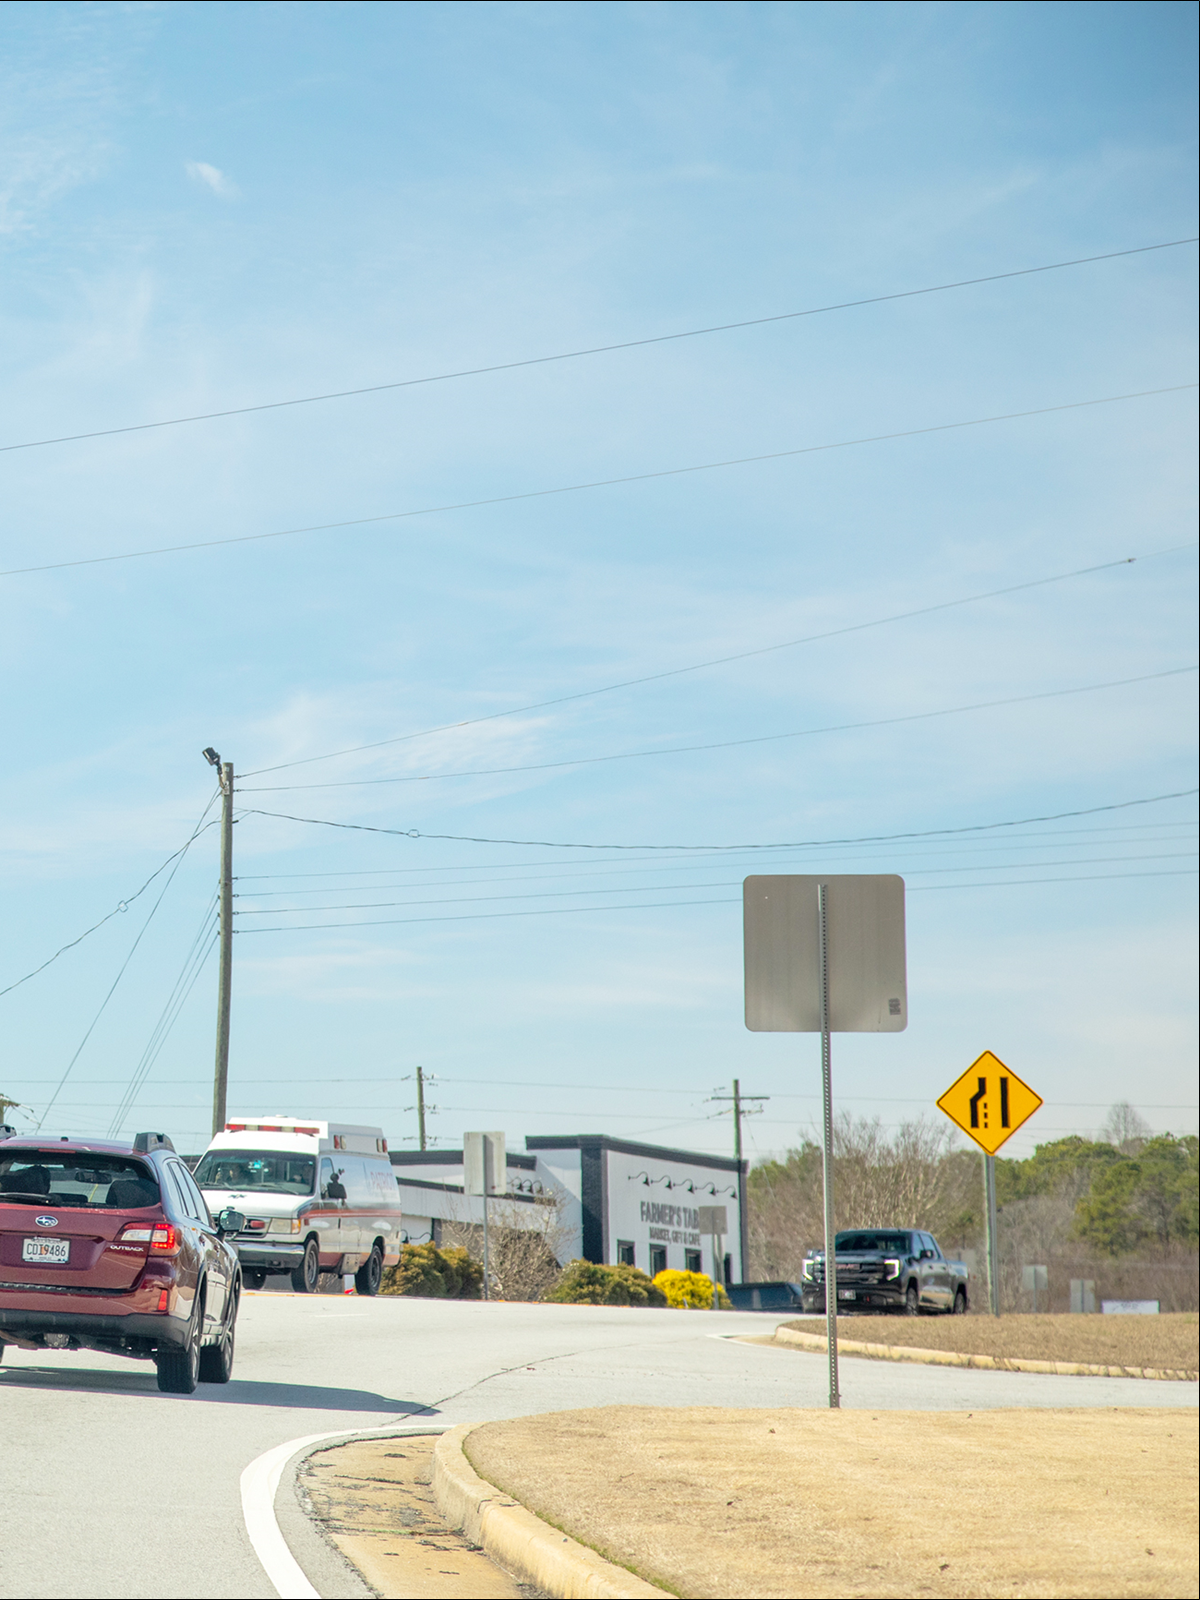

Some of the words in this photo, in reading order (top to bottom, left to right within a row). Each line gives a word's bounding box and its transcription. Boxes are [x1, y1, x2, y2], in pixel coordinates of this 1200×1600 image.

[640, 1200, 683, 1228] FARMER'S
[682, 1206, 700, 1230] TAB
[110, 1244, 144, 1252] OUTBACK
